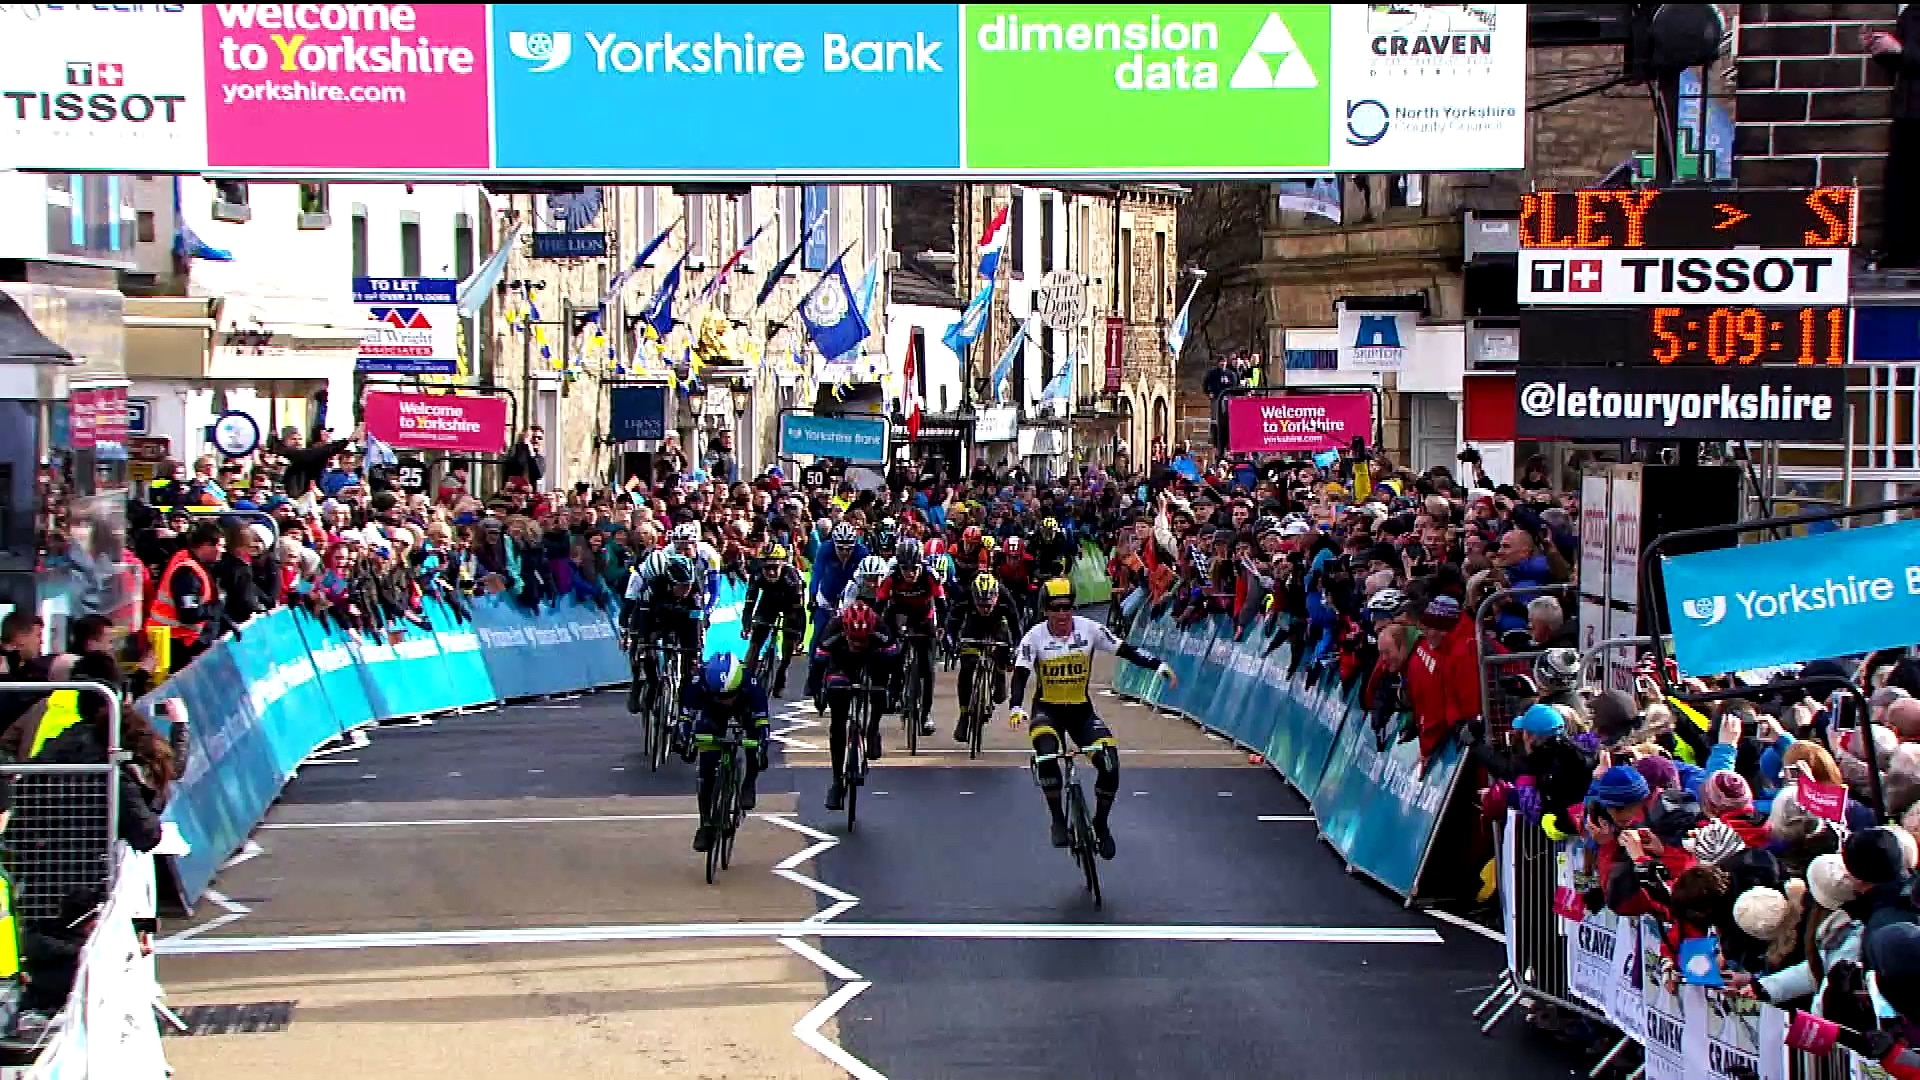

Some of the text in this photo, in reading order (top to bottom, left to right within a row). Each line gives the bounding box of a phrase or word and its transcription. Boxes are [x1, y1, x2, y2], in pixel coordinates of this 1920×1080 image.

[977, 16, 1219, 51] dimension
[1371, 35, 1491, 56] CRAVEN
[219, 35, 474, 74] to Yorkshire
[585, 32, 944, 73] Yorkshire Bank
[1115, 53, 1219, 90] data
[222, 80, 406, 104] yorkshire.com
[2, 92, 186, 122] TISSOT
[1396, 106, 1517, 119] North Yorkshire
[368, 279, 420, 291] TO LET
[1621, 257, 1832, 293] TISSOT
[1651, 307, 1845, 365] 5:09:11
[400, 402, 463, 417] Welcome
[1261, 405, 1325, 418] Welcome
[1521, 380, 1832, 427] @letouryorkshire
[400, 415, 481, 432] to Yorkshire
[1263, 418, 1344, 432] to Yorkshire
[400, 467, 422, 487] 25
[807, 471, 823, 485] 50
[1736, 576, 1895, 621] Yorkshire
